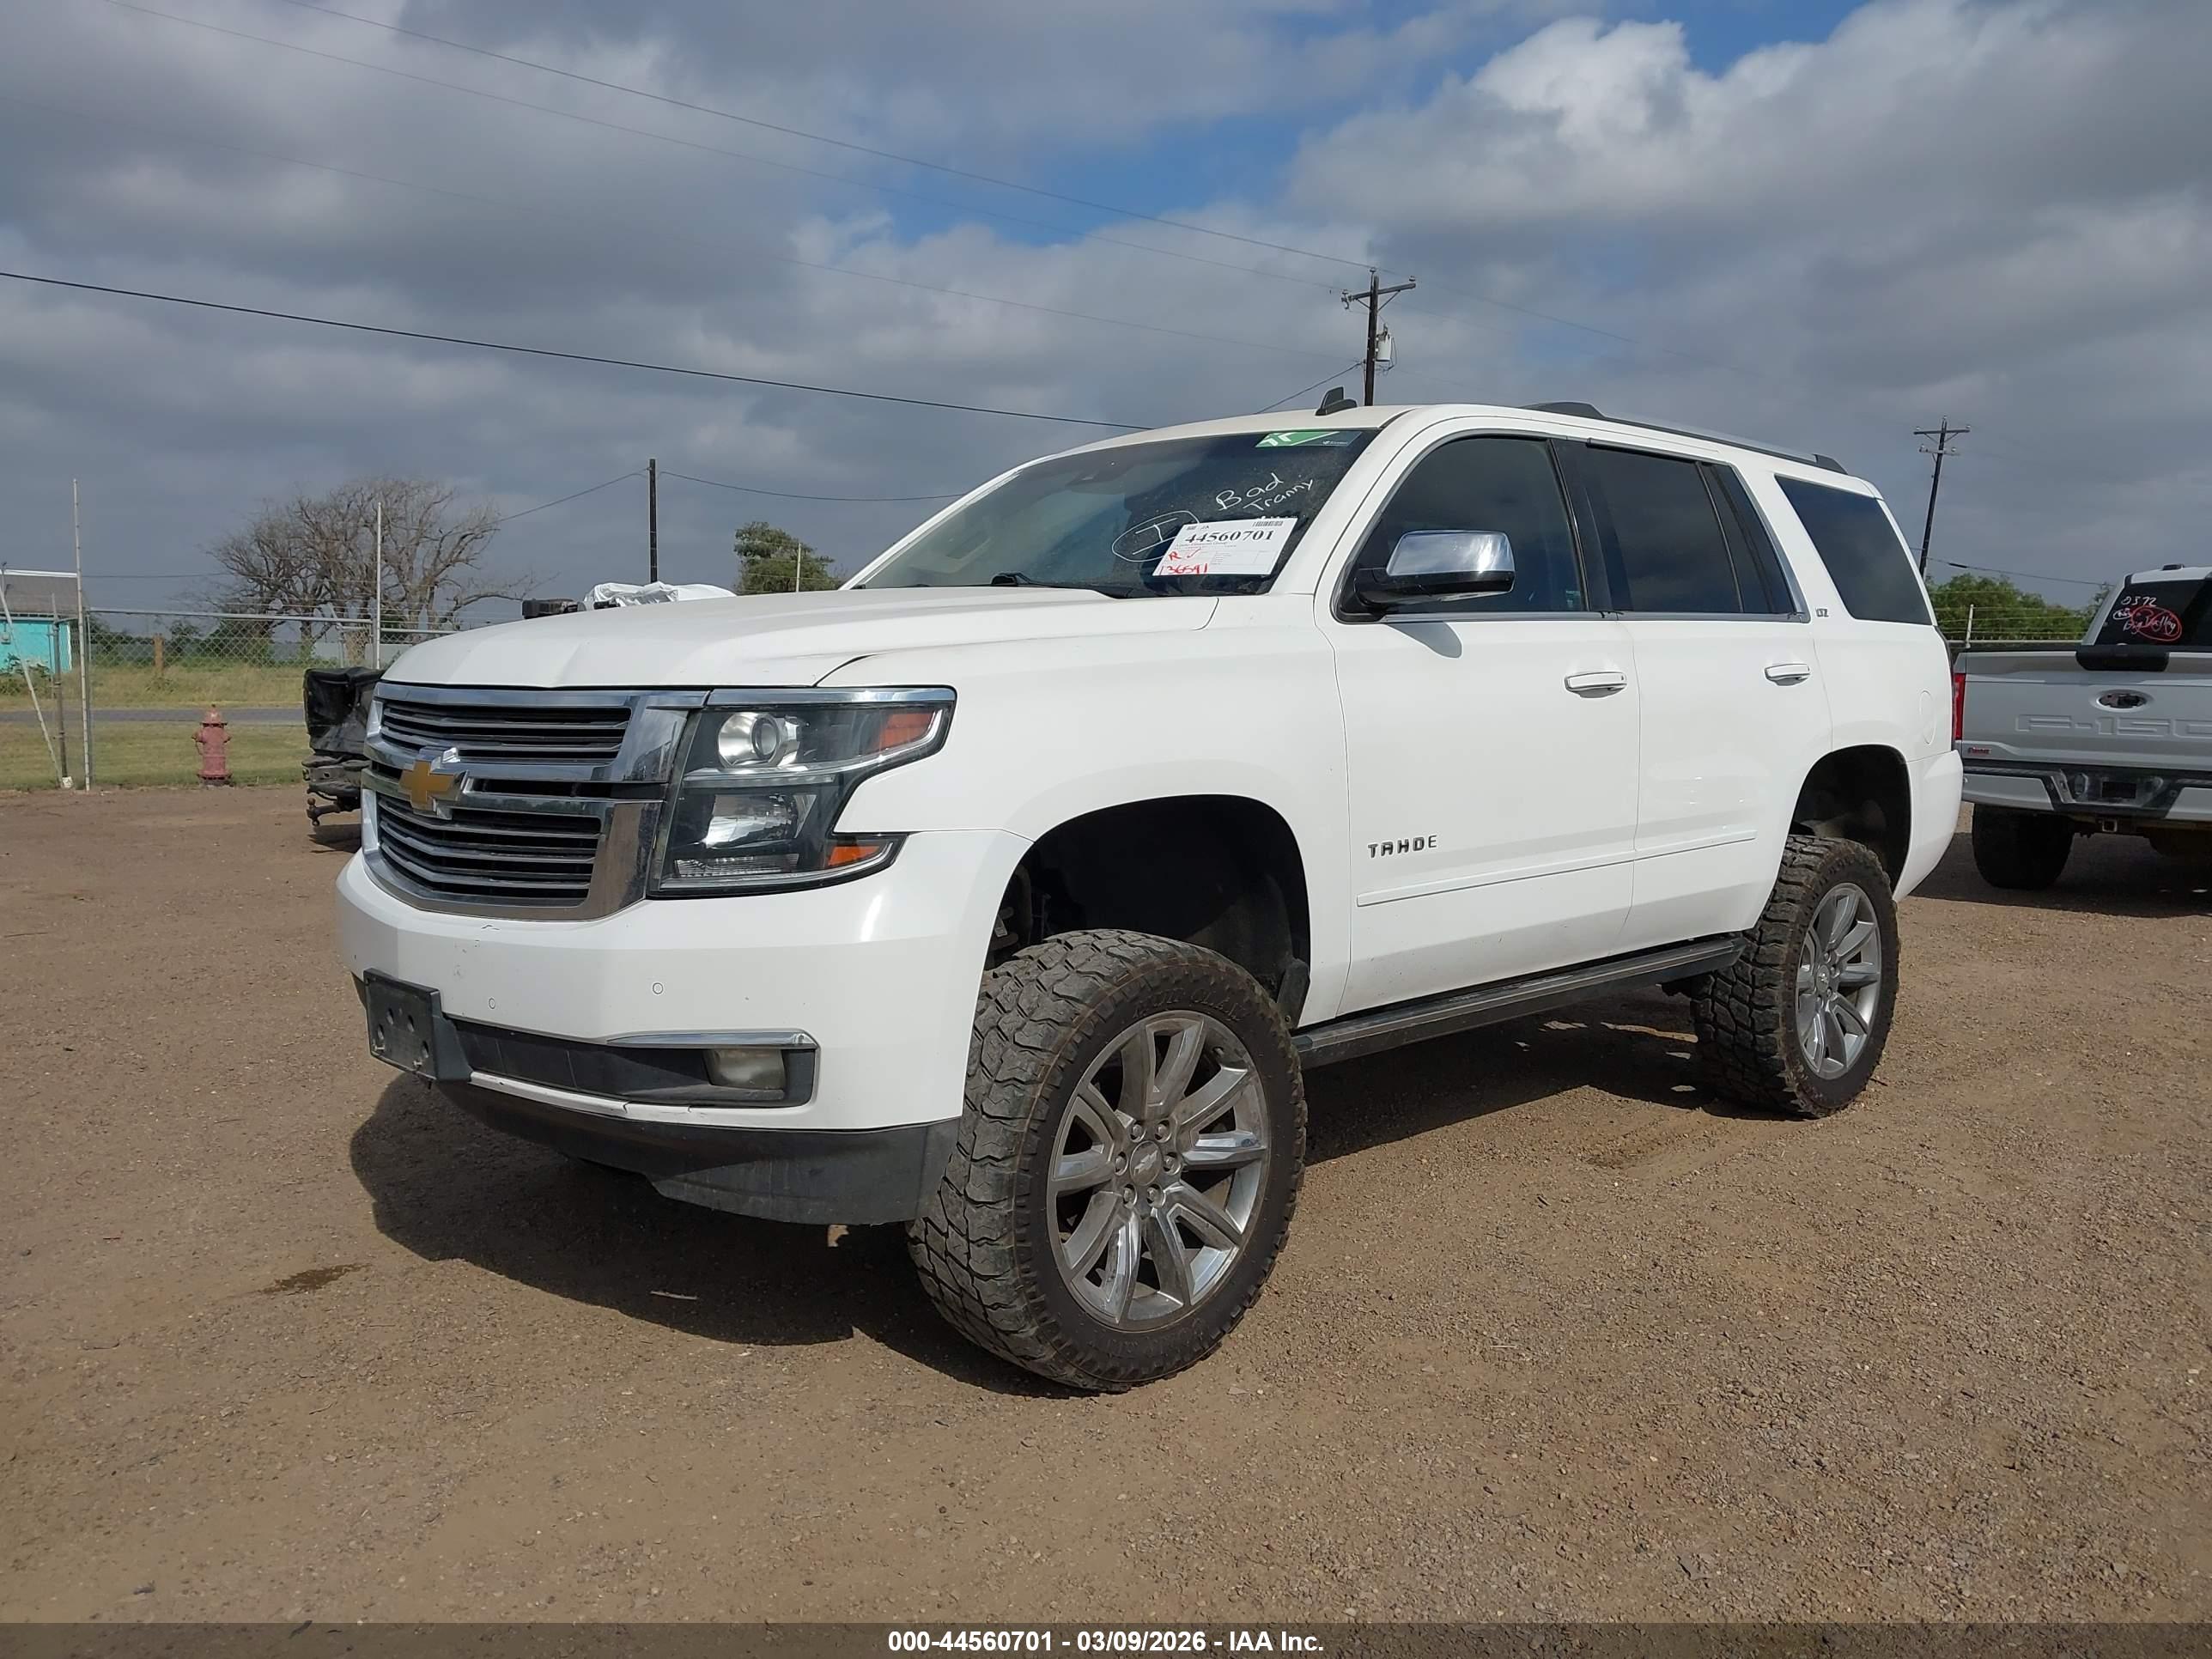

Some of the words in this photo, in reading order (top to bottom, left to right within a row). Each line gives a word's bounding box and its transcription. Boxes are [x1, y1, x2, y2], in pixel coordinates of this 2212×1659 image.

[1215, 472, 1285, 511] Bad
[1242, 478, 1314, 512] Tranny
[1185, 530, 1275, 544] 44560701
[1367, 835, 1438, 859] TAHOE
